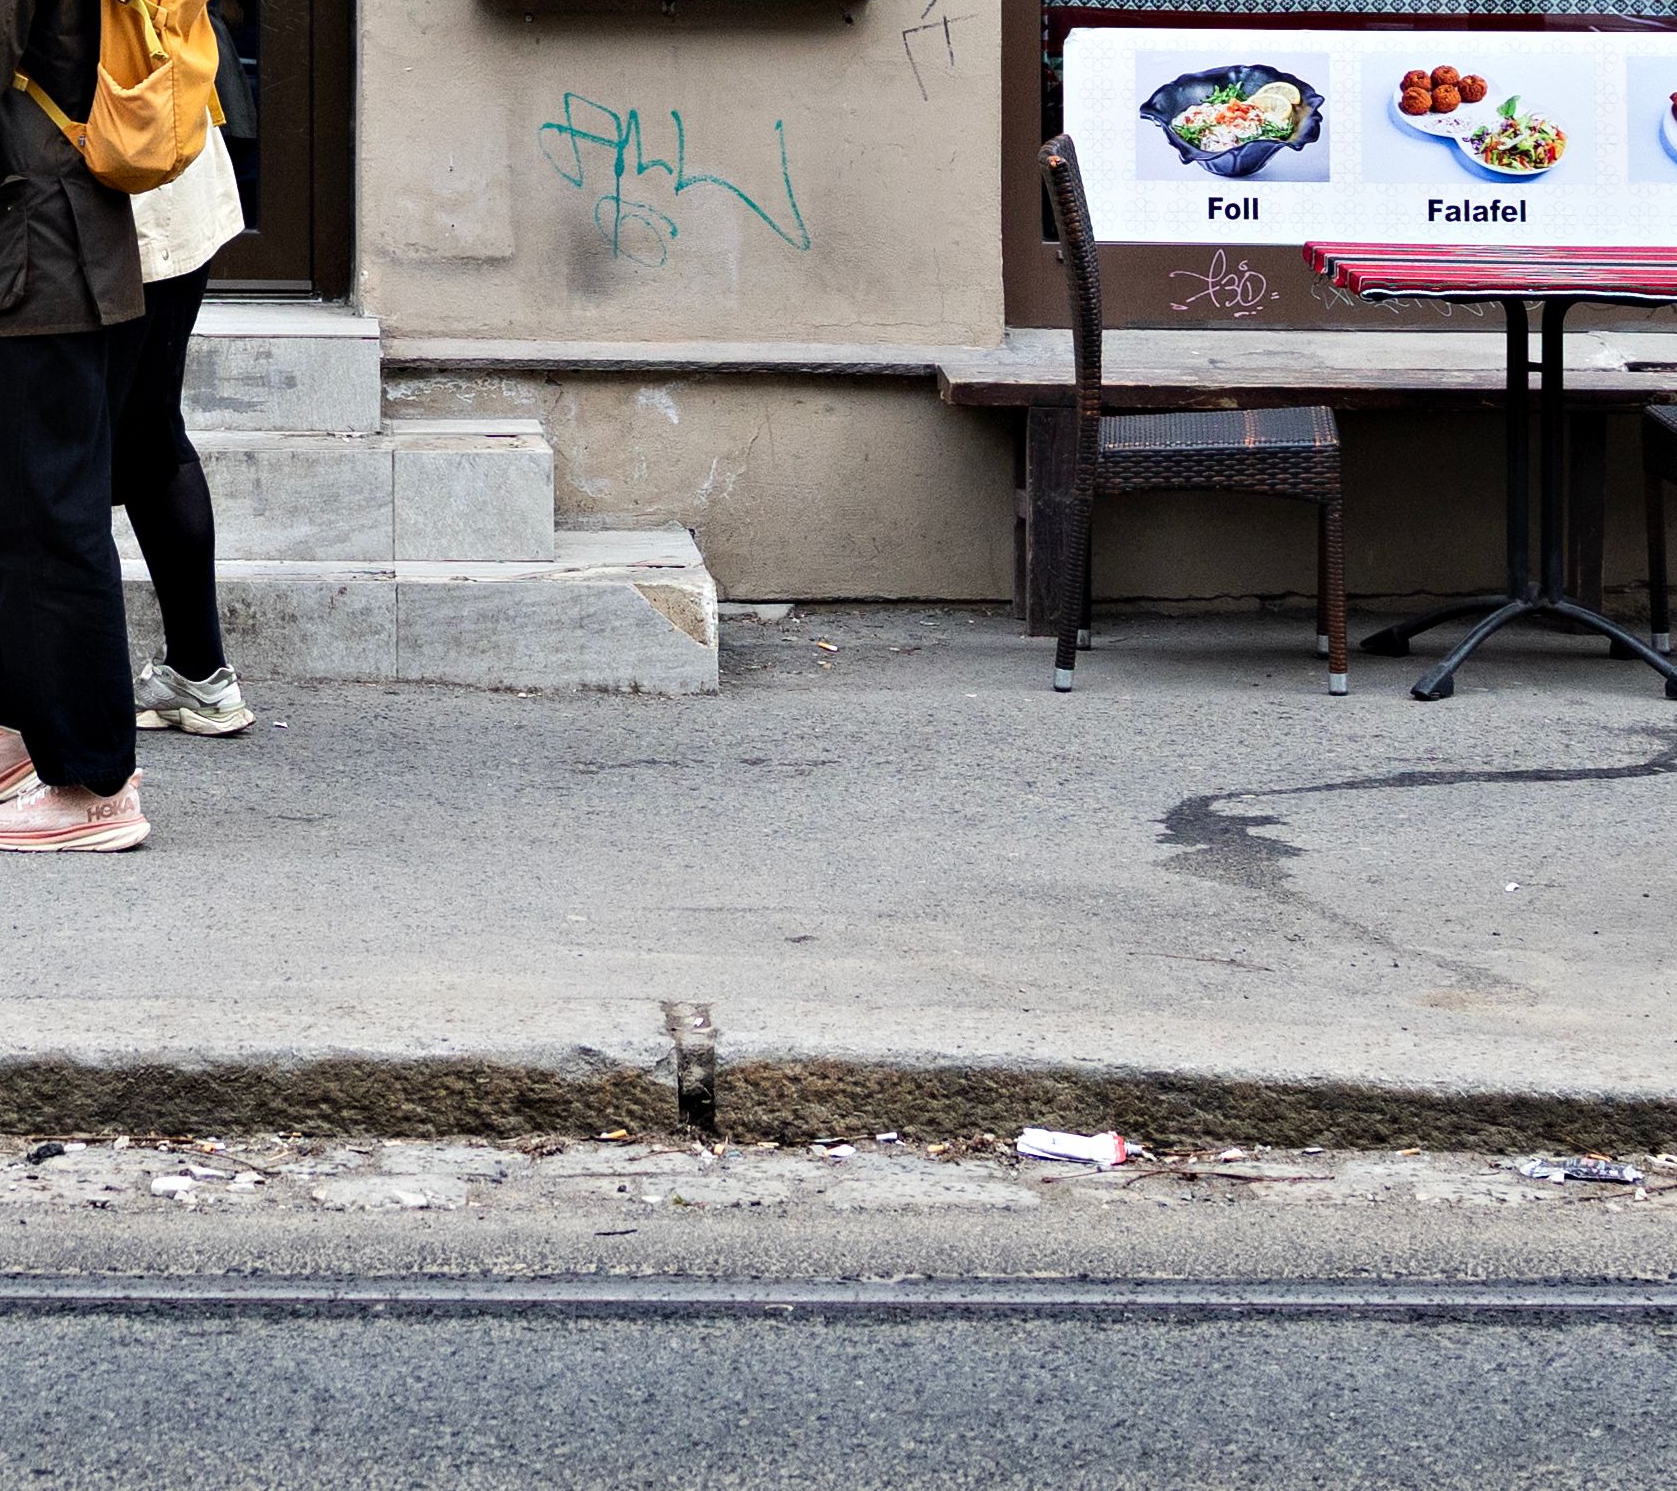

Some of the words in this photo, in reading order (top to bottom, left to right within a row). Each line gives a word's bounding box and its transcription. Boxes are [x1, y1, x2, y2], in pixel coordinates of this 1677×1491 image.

[1207, 196, 1260, 222] Foll
[1427, 198, 1528, 224] Falafel
[86, 796, 135, 823] HOKA
